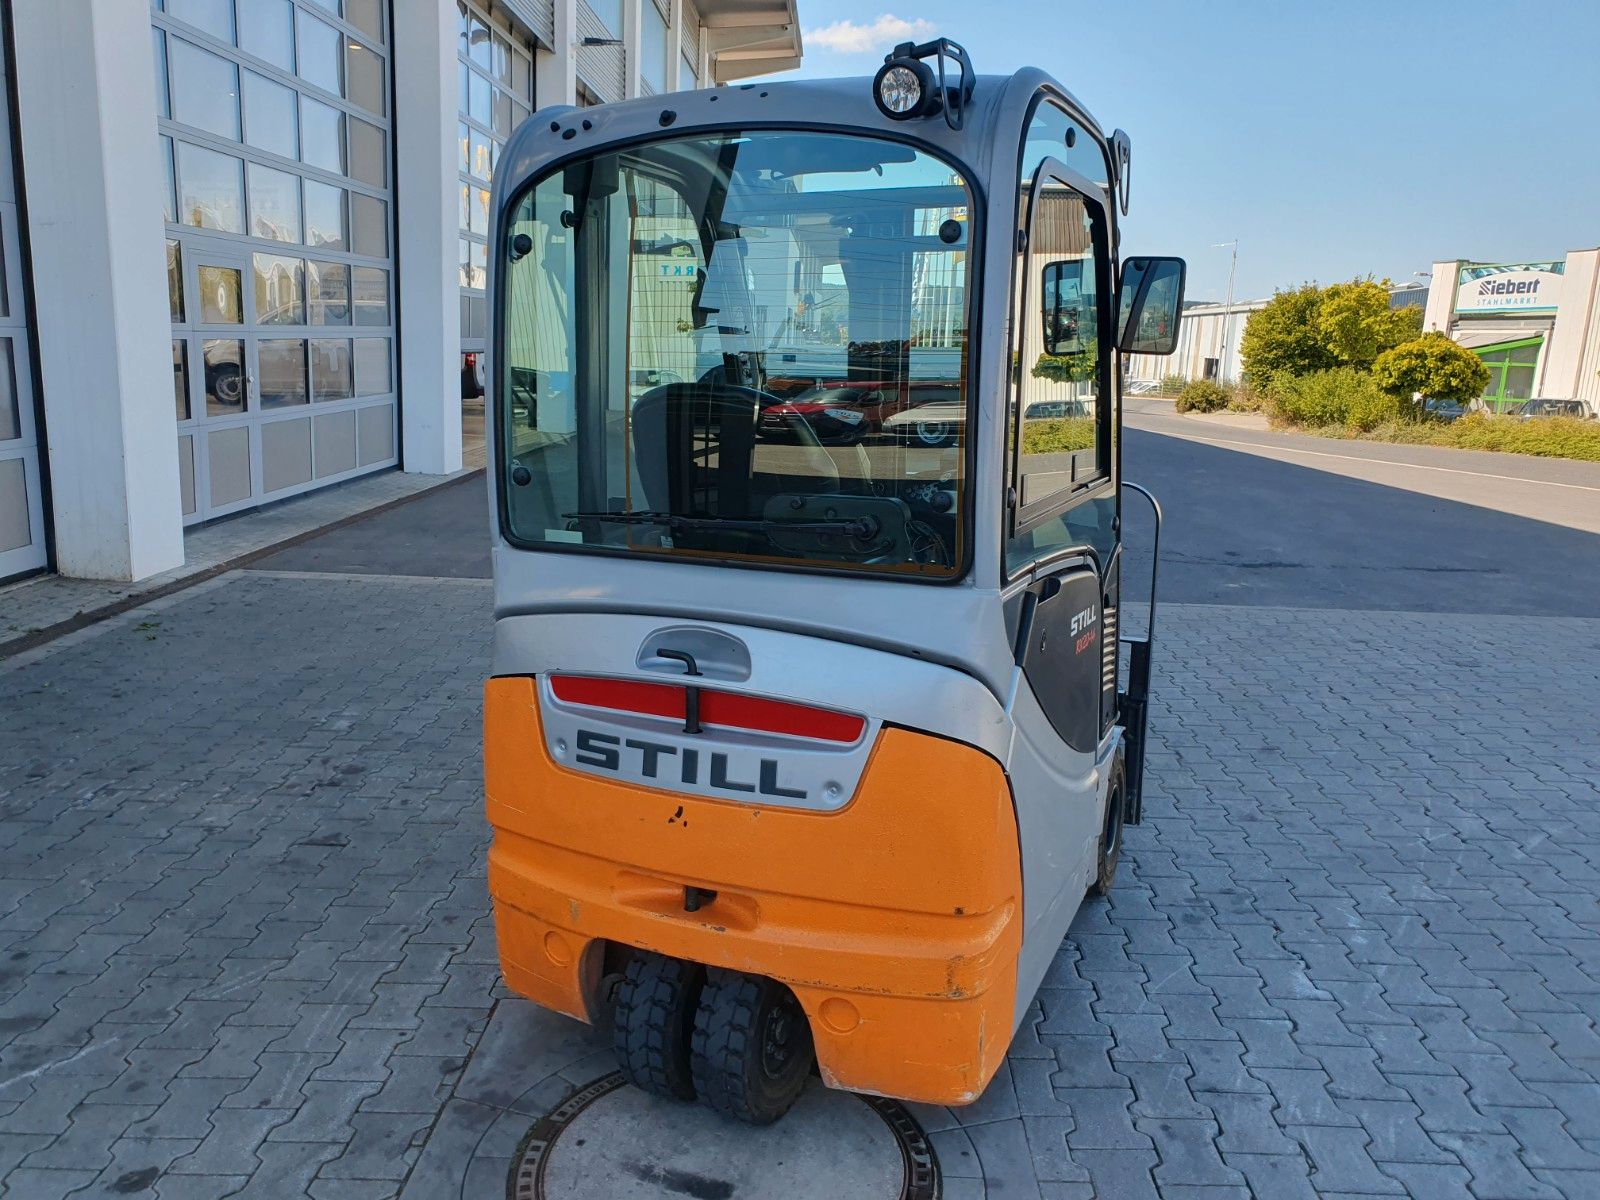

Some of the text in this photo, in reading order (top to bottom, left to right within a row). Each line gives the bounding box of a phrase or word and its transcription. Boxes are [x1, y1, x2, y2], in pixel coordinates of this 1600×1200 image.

[1478, 278, 1540, 296] Siebert
[1477, 297, 1538, 306] STAHLMARKT
[1070, 604, 1096, 637] STILL
[576, 729, 807, 799] STILL
